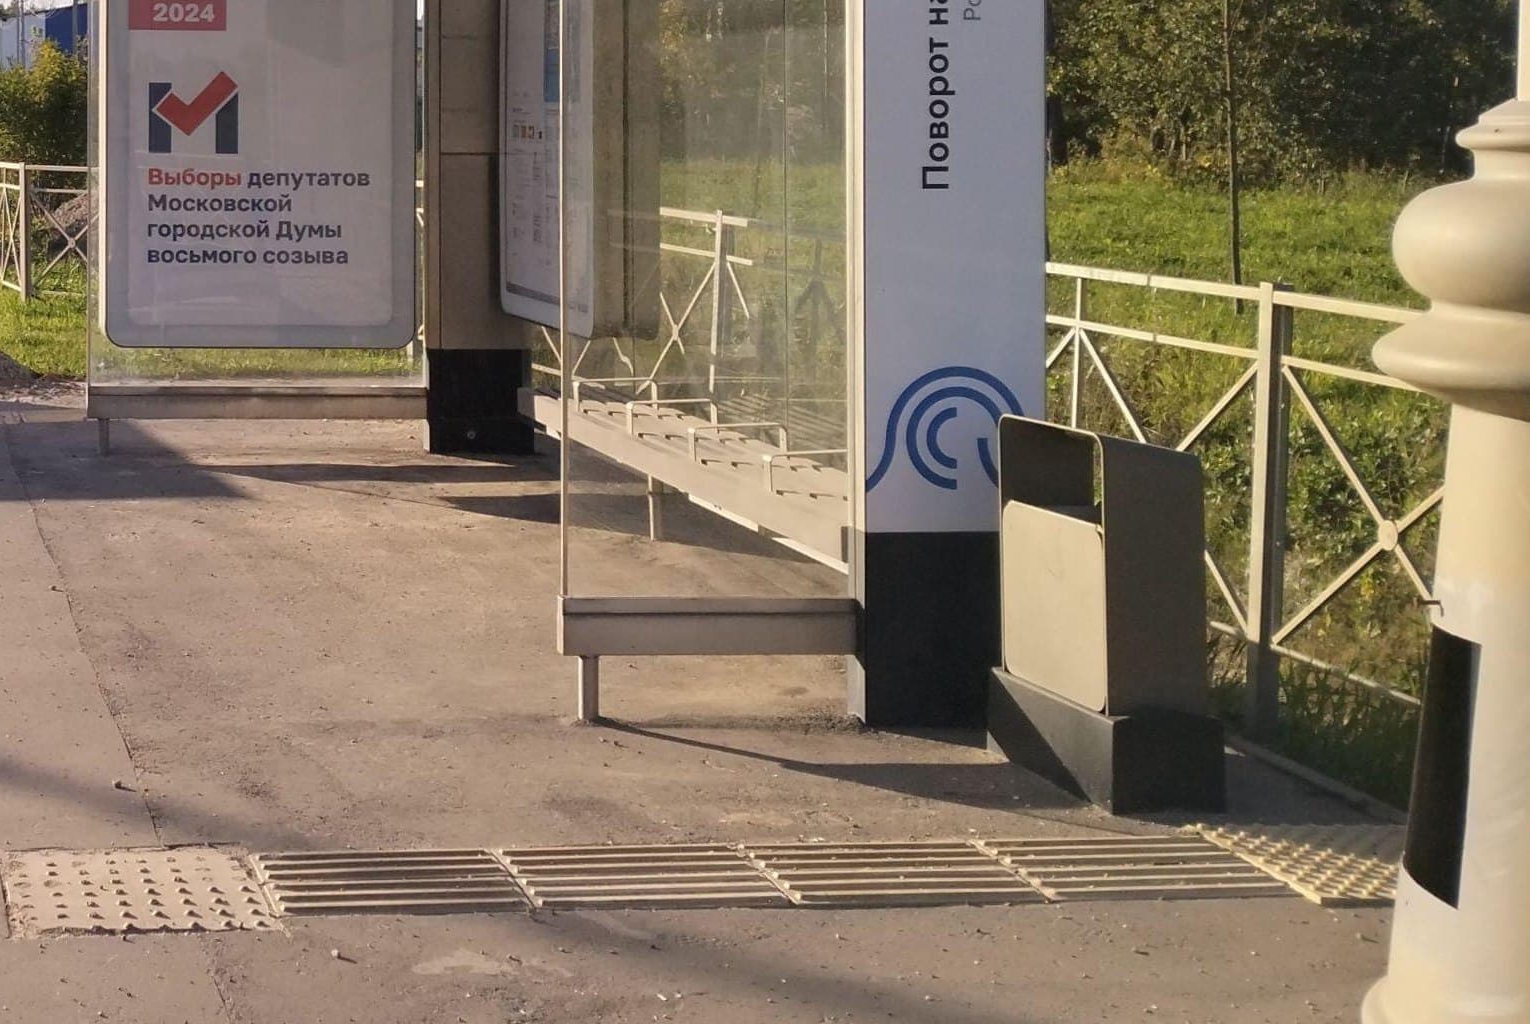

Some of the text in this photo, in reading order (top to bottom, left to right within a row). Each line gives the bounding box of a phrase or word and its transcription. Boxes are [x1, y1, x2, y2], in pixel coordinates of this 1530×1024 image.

[153, 2, 215, 23] 2024
[922, 38, 956, 191] Поворот
[148, 168, 371, 191] Выборы депутатов
[148, 194, 292, 213] Московской
[148, 220, 343, 243] городской Думы
[148, 250, 350, 266] восьмого созыва
